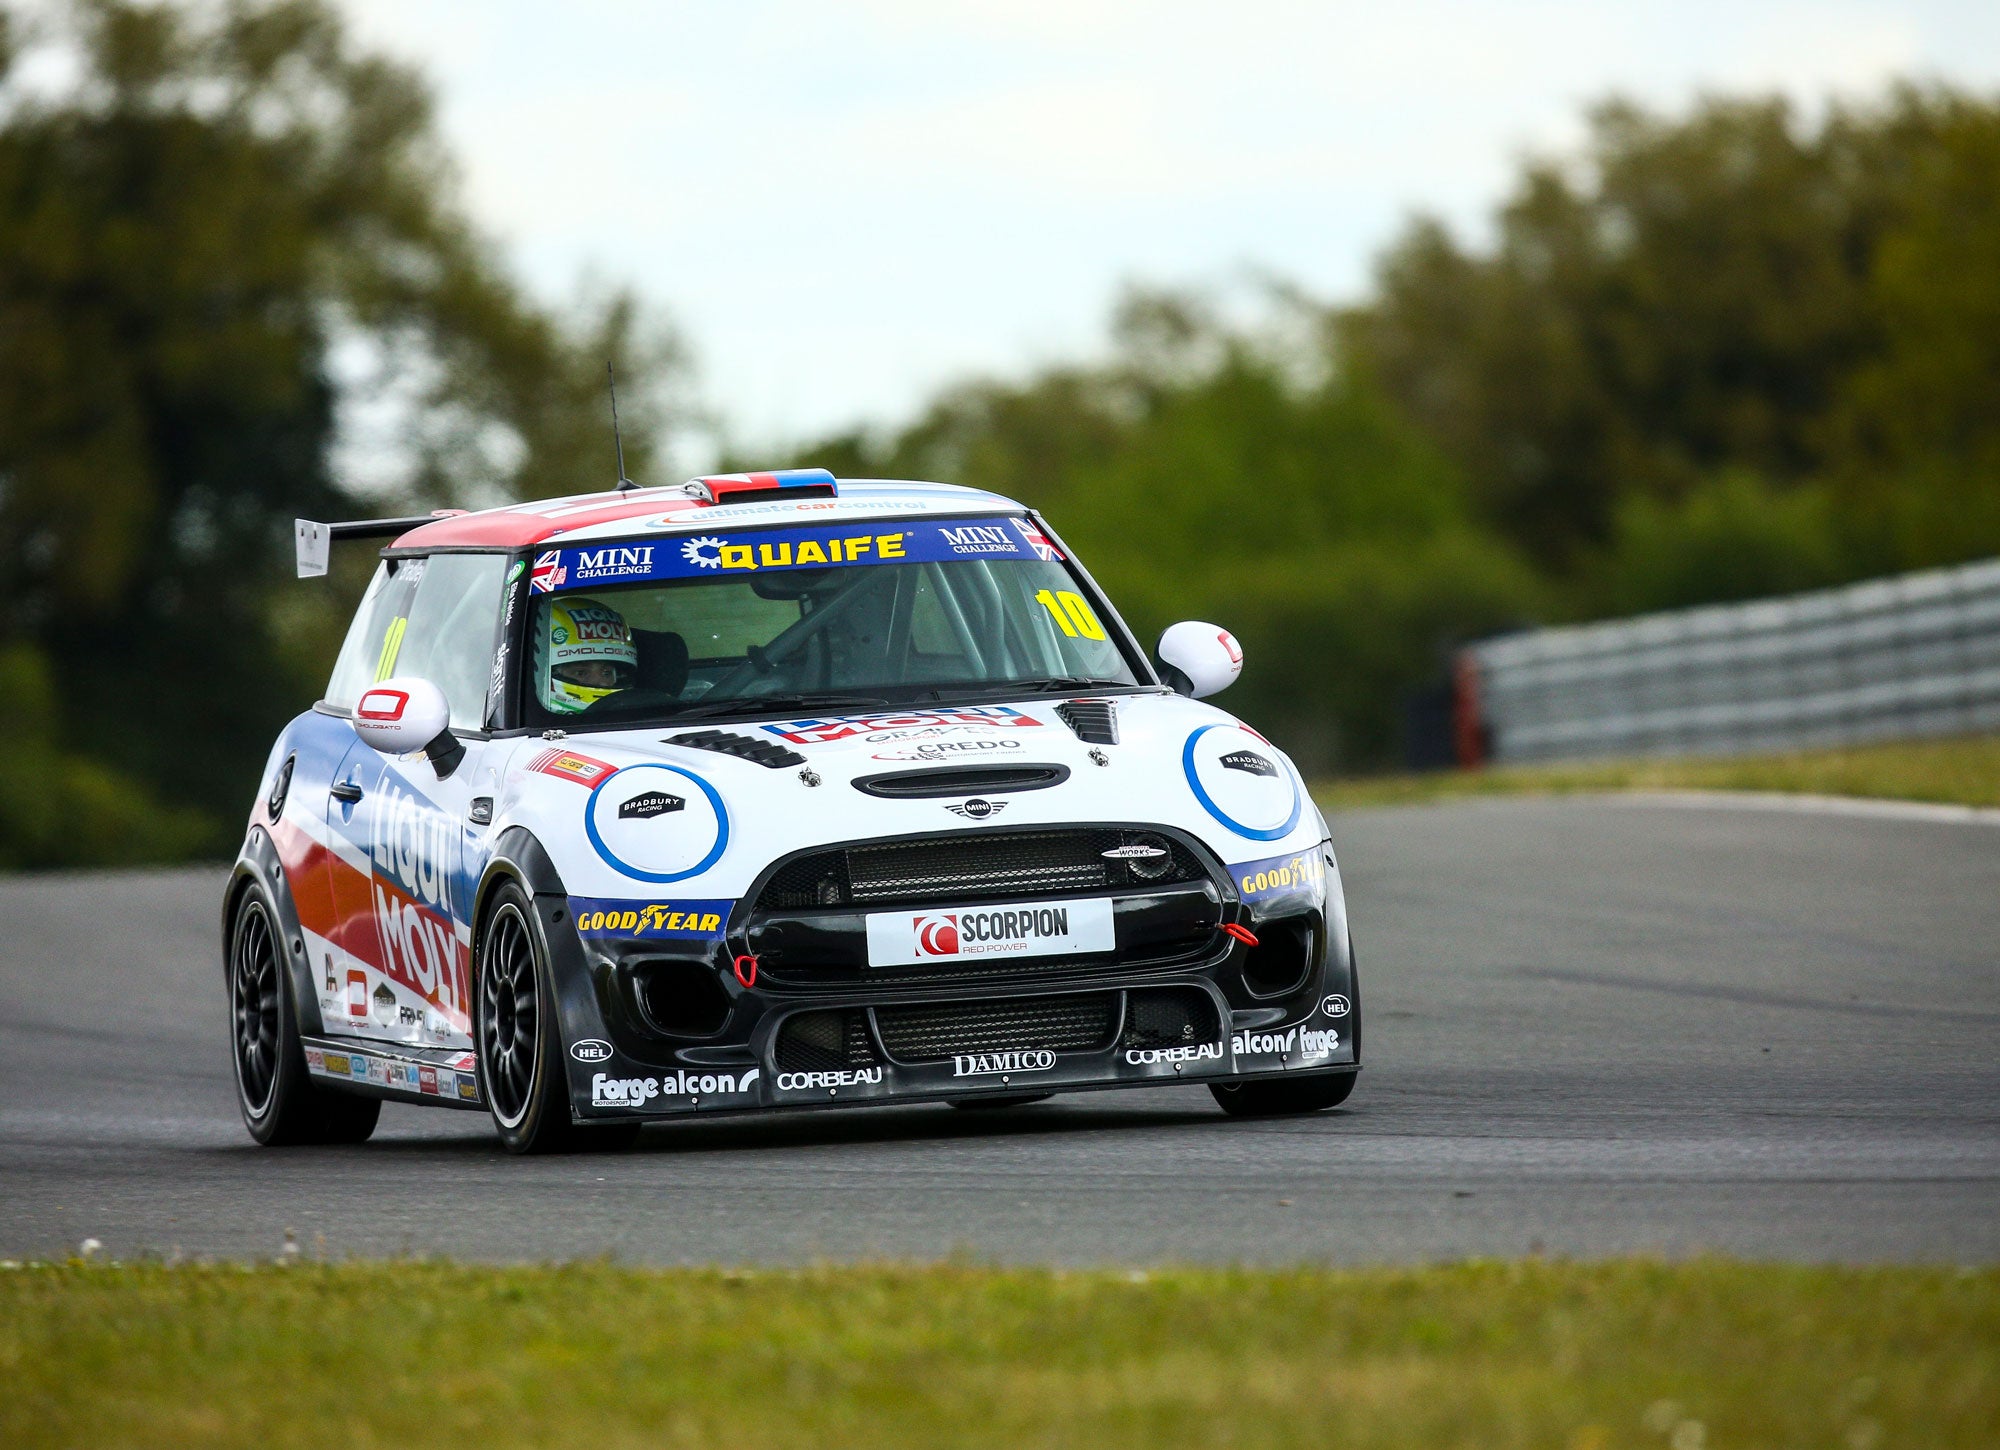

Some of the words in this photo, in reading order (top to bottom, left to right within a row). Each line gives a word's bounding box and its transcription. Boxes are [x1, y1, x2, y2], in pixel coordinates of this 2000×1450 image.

[938, 526, 1013, 545] MINI
[577, 547, 655, 570] MINI
[718, 533, 906, 571] QUAIFE
[953, 544, 1019, 554] CHALLENGE
[576, 565, 651, 579] CHALLENGE
[1034, 589, 1106, 641] 10
[579, 622, 626, 641] MOLY
[793, 714, 1026, 743] MOLY
[917, 740, 1021, 753] CREDO
[1225, 756, 1274, 770] BRADBURY
[624, 797, 679, 811] BRADBURY
[637, 805, 662, 813] RACING
[966, 803, 990, 812] MINI
[374, 776, 449, 912] LIQUI
[1119, 849, 1150, 857] WORKS
[961, 908, 1068, 942] SCORPION
[376, 883, 459, 1016] MOLY
[963, 945, 985, 954] RED
[987, 943, 1027, 952] POWER
[1327, 1004, 1347, 1014] HEL
[579, 1048, 606, 1058] HEL
[1125, 1041, 1223, 1065] CORBEAU
[951, 1050, 1053, 1077] DAMICO
[663, 1070, 735, 1094] alcon
[777, 1066, 882, 1090] CORBEAU
